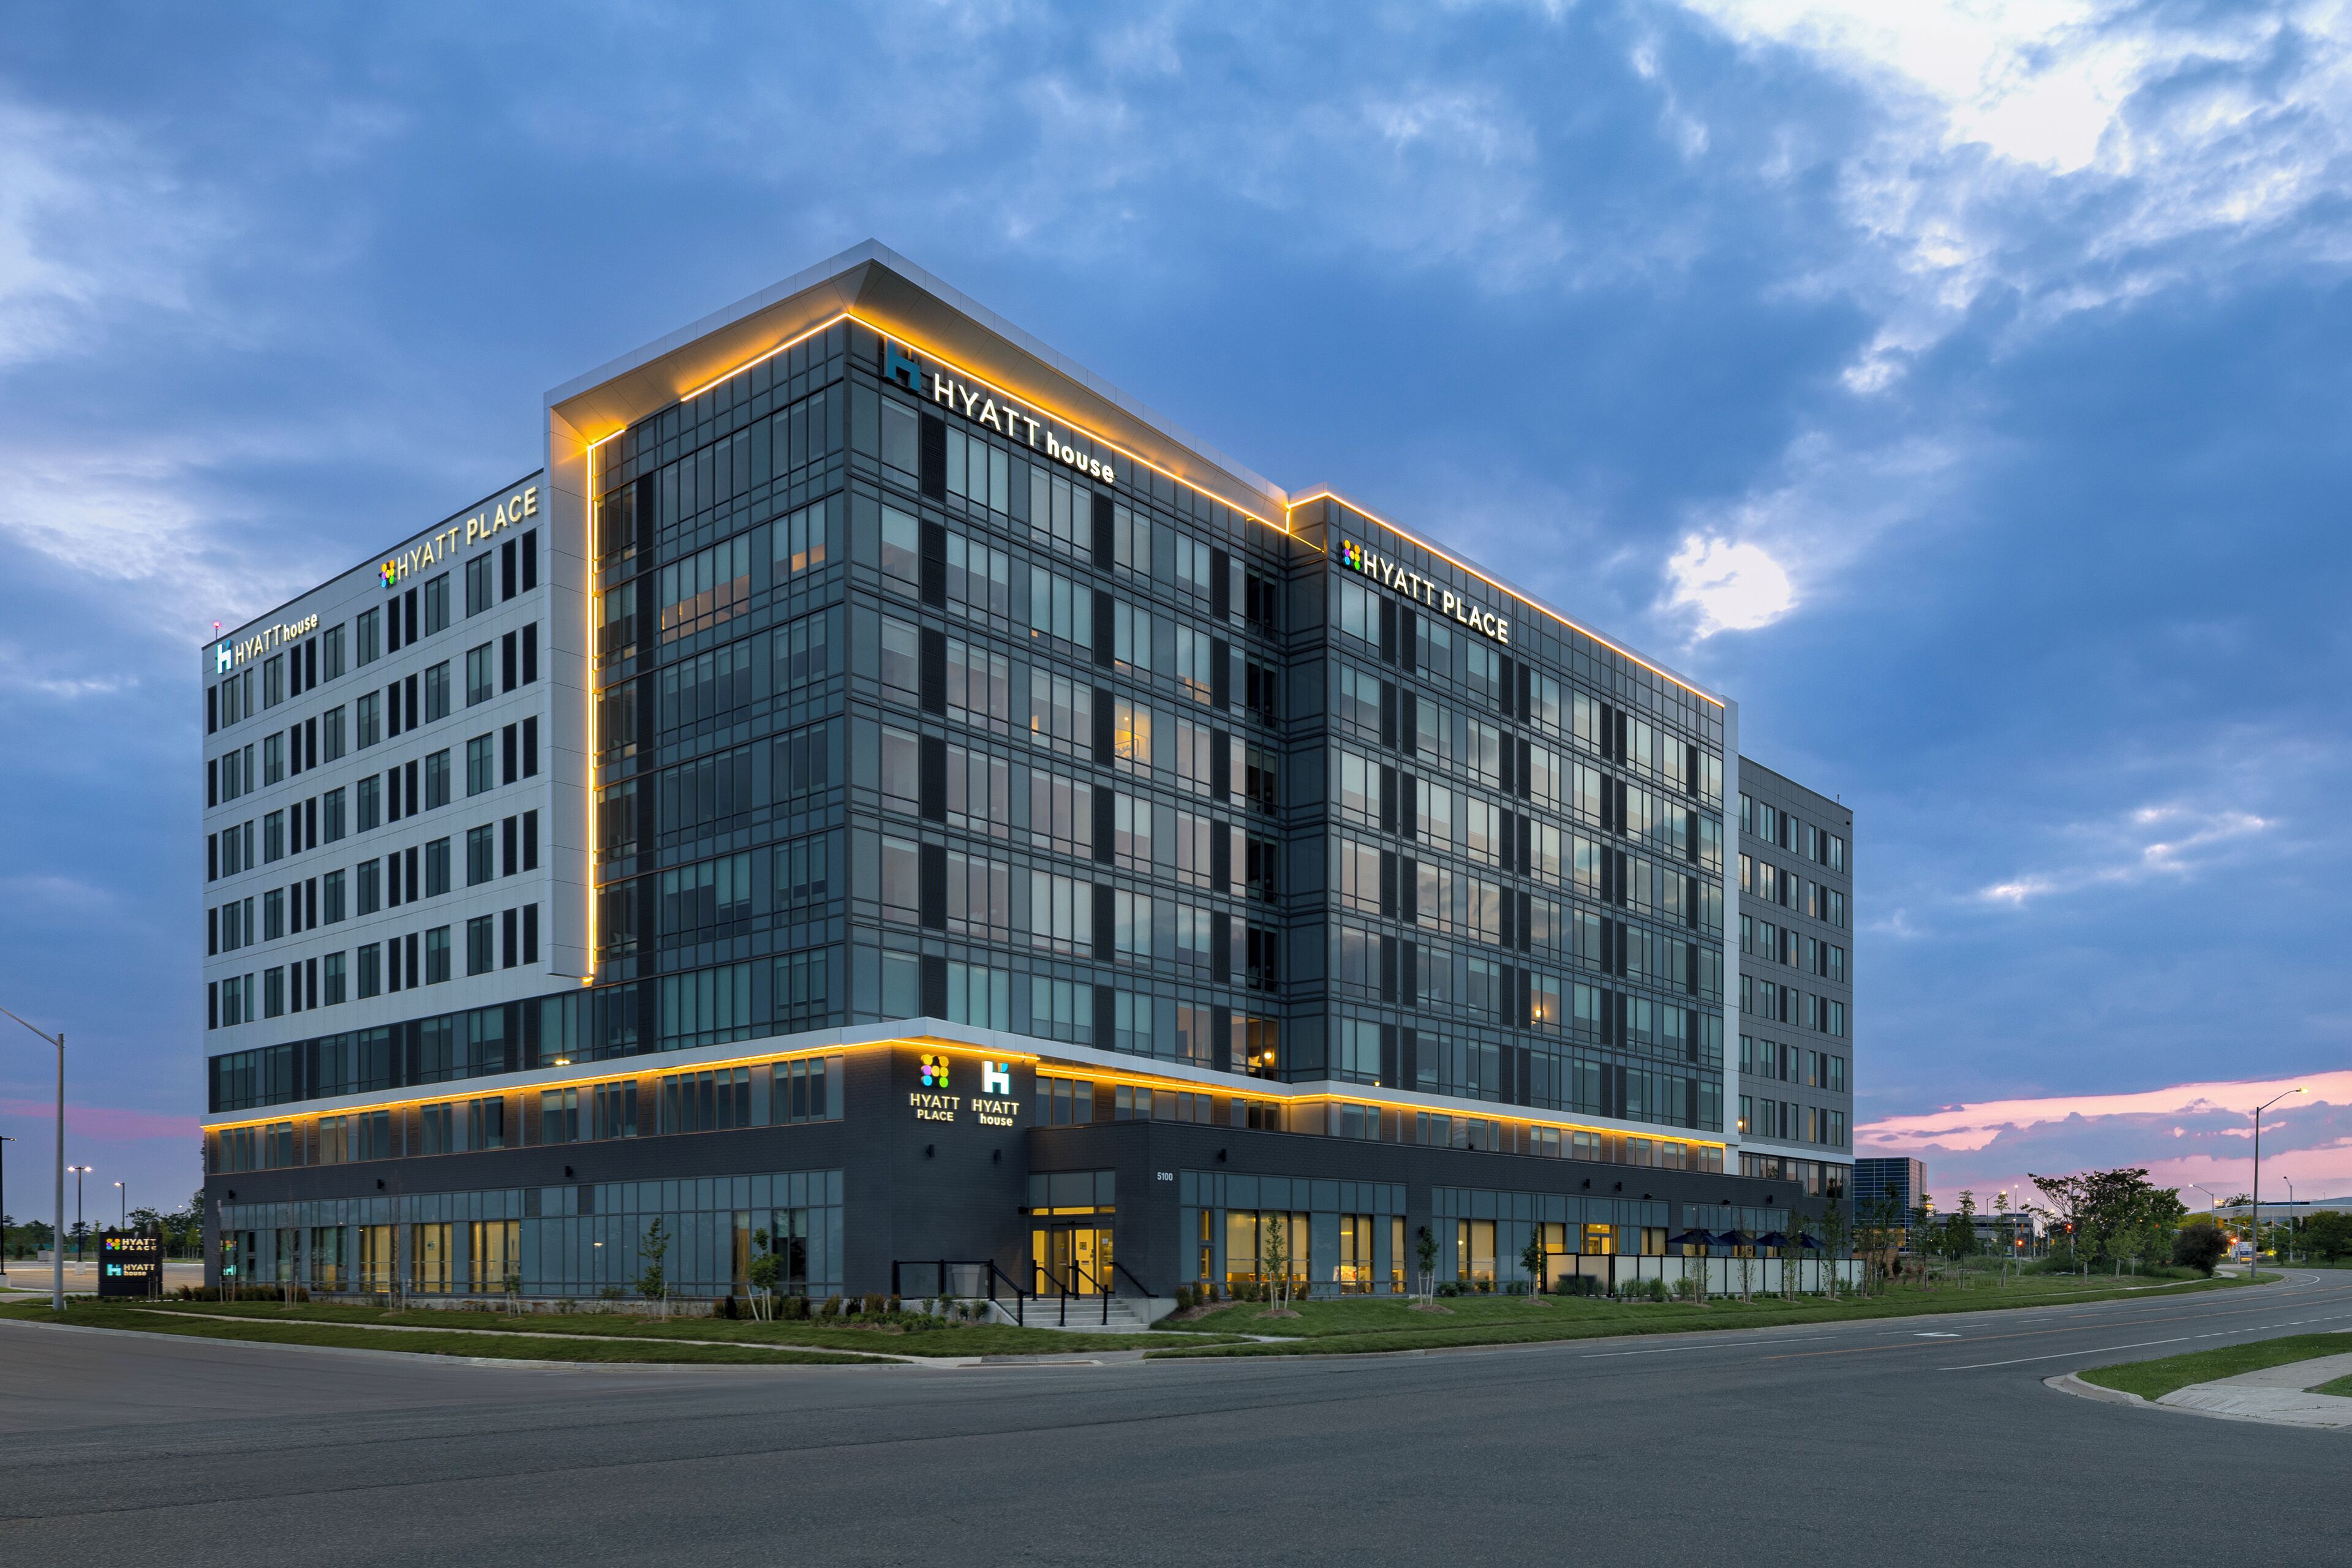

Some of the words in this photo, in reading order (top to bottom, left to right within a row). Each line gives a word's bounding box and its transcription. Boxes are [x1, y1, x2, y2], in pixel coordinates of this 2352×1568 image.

[933, 372, 1041, 447] HYATT
[1046, 431, 1115, 484] house
[397, 527, 459, 581] HYATT
[466, 486, 537, 546] PLACE
[1363, 549, 1435, 606] HYATT
[1442, 589, 1509, 644] PLACE
[235, 624, 282, 666] HYATT
[283, 613, 318, 642] house
[910, 1093, 960, 1110] HYATT
[971, 1098, 1020, 1115] HYATT
[916, 1109, 954, 1121] PLACE
[979, 1113, 1013, 1126] house
[1157, 1172, 1173, 1181] 5100
